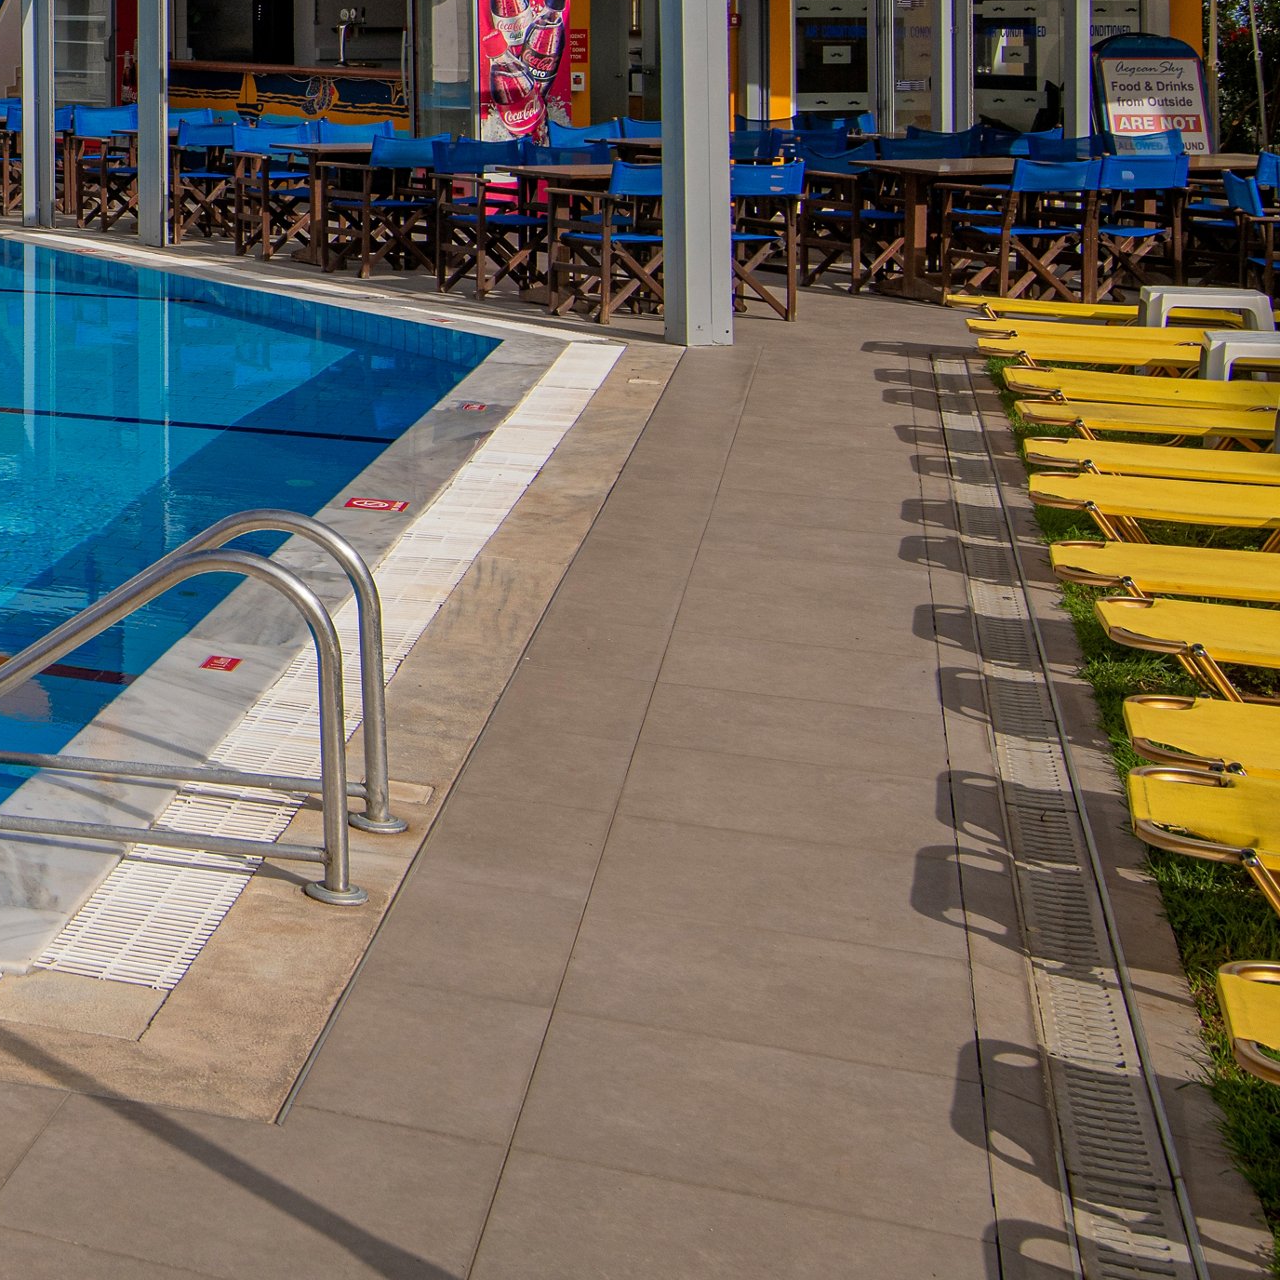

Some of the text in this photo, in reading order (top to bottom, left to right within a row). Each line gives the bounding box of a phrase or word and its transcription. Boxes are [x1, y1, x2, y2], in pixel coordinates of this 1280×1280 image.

[1090, 25, 1131, 37] ONDITIONED
[1115, 61, 1184, 79] Aegean Sky
[1111, 81, 1195, 92] Food & Drinks
[1117, 96, 1193, 107] from Outside
[1119, 116, 1196, 130] ARE NOT
